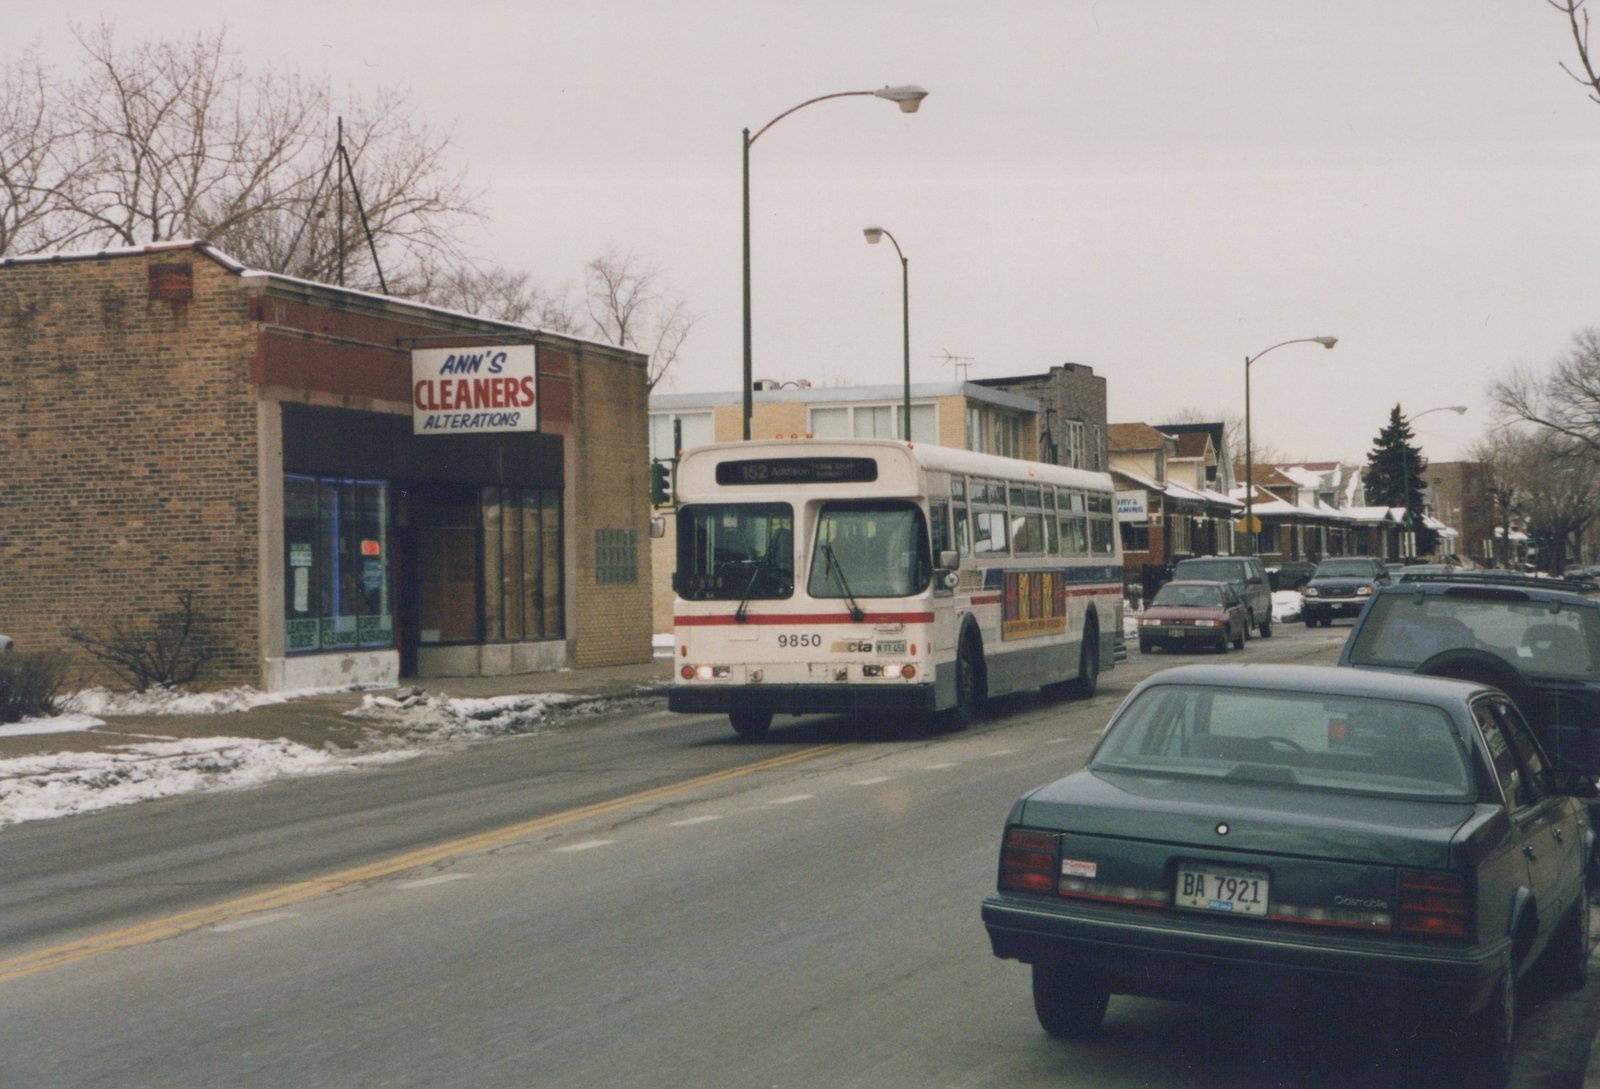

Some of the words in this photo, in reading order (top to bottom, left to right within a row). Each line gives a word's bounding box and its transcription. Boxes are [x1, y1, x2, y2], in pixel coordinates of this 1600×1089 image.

[439, 350, 507, 375] ANN'S
[414, 376, 535, 411] CLEANERS
[423, 412, 520, 429] ALTERATIONS
[742, 463, 768, 480] 152
[778, 634, 822, 648] 9850
[846, 640, 873, 653] cta
[1183, 872, 1205, 897] BA
[1214, 876, 1261, 904] 7921
